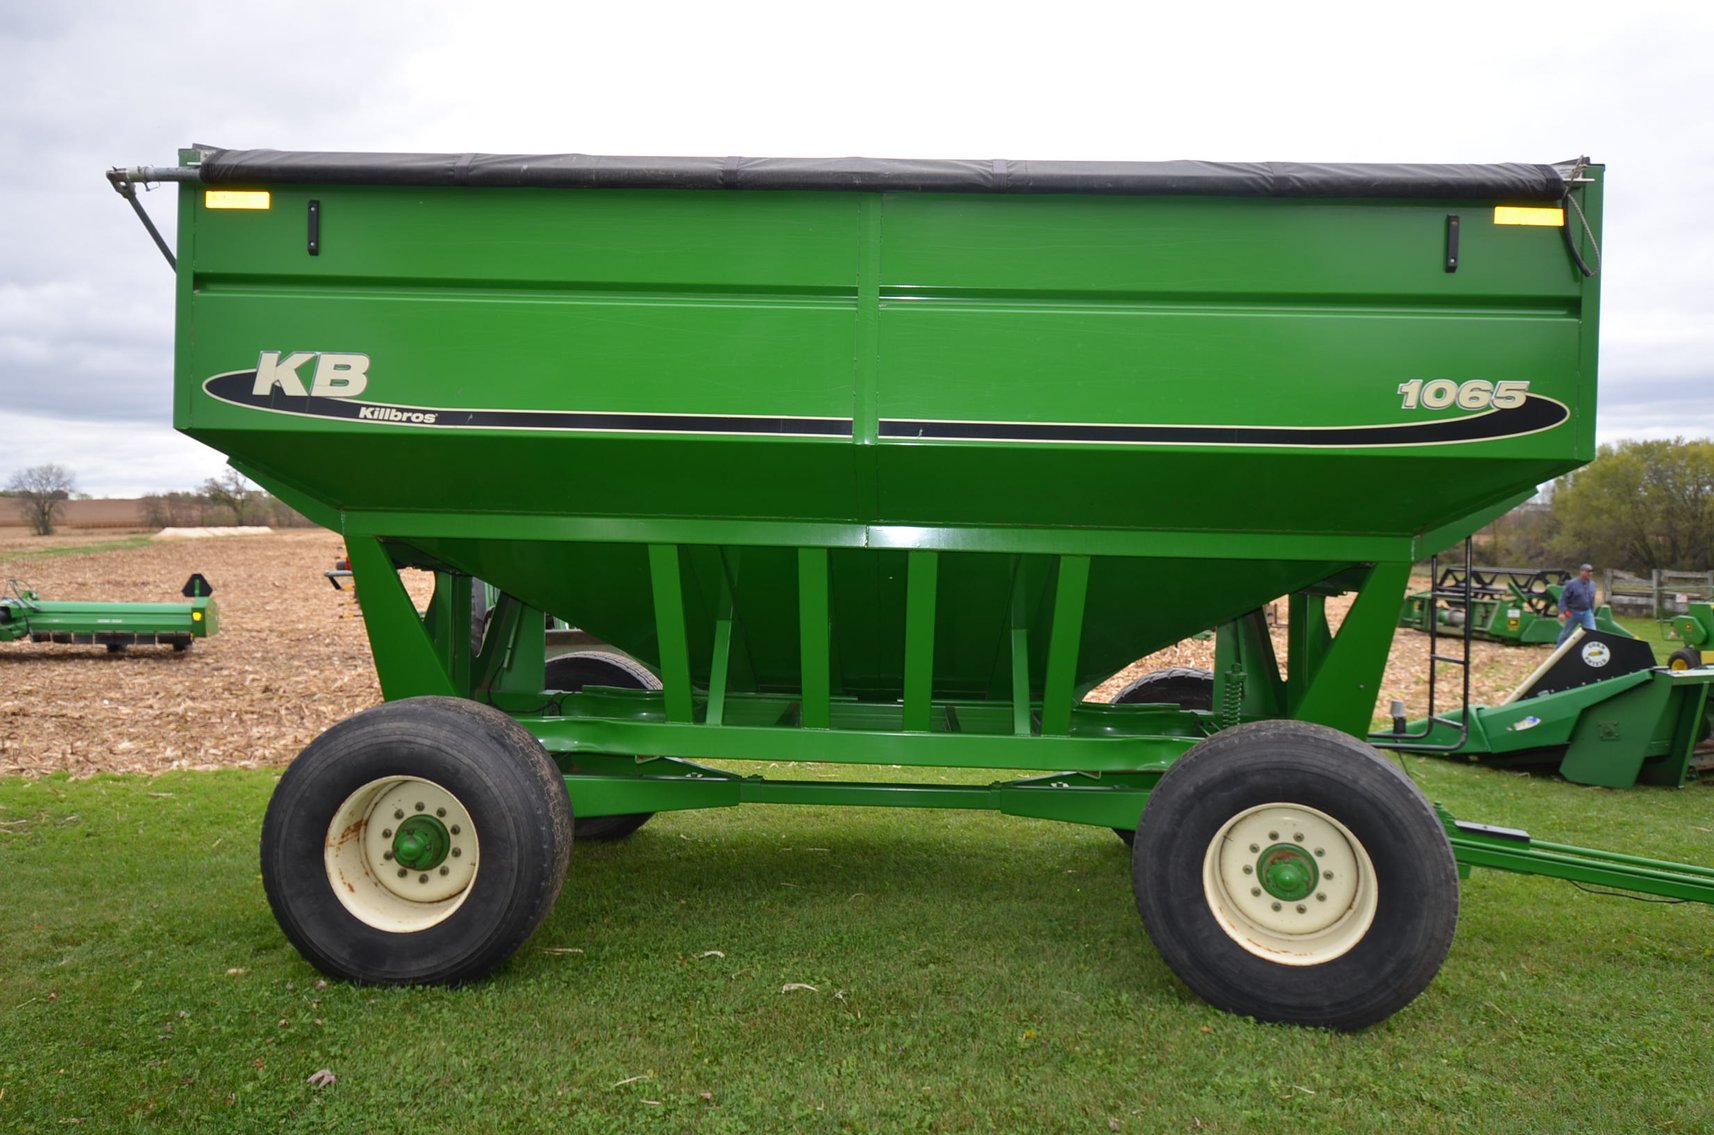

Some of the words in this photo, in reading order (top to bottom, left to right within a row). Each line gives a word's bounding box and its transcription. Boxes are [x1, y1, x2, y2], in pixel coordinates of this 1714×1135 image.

[252, 351, 370, 397] KB
[1397, 379, 1530, 410] 1065
[359, 406, 436, 424] Killbros
